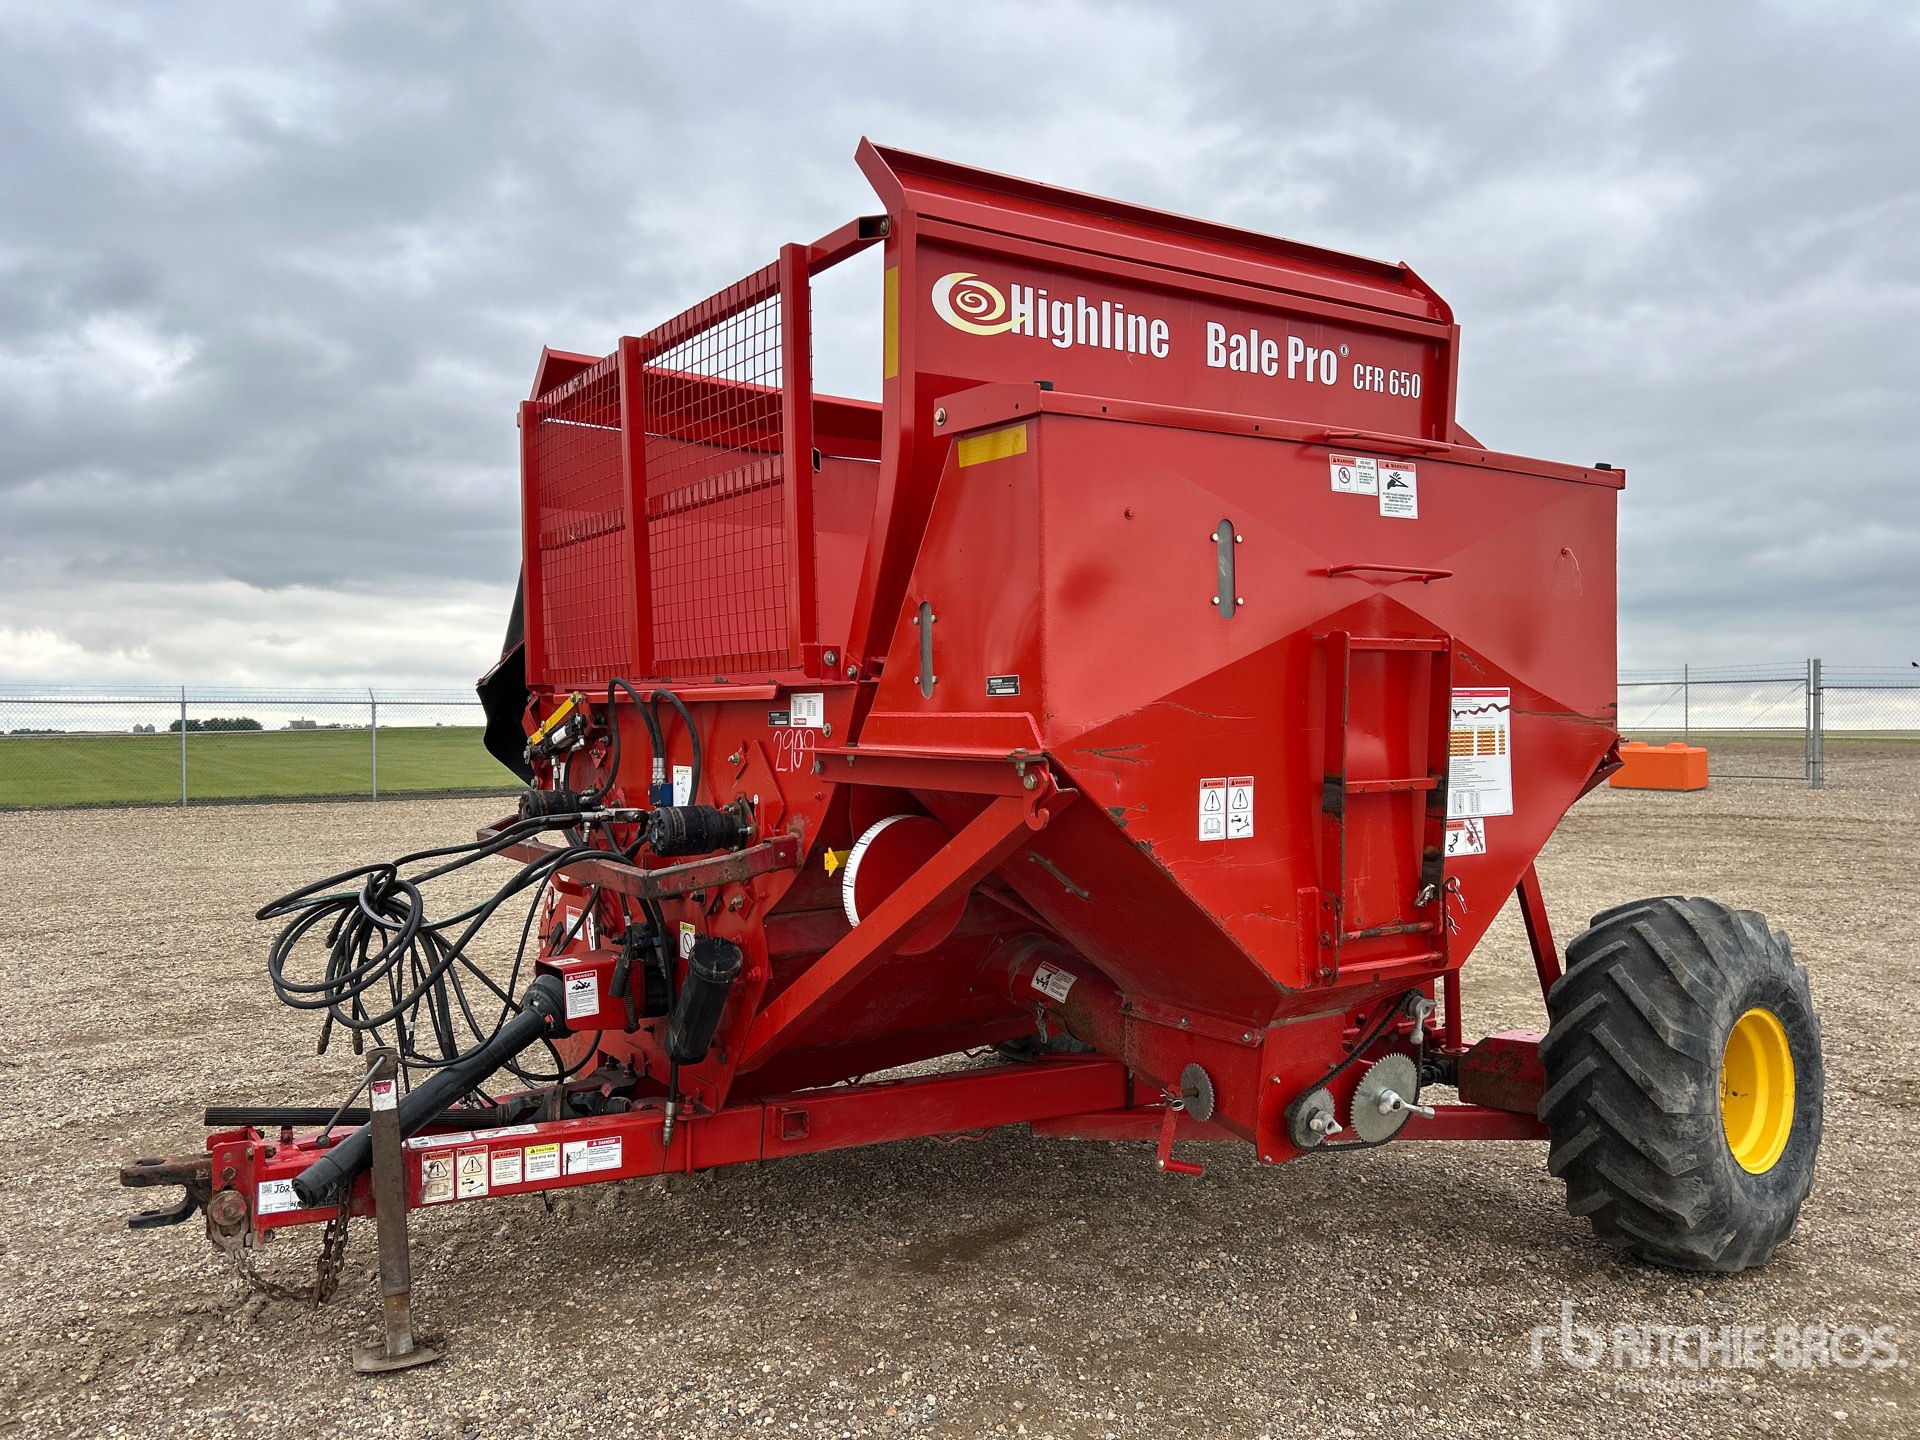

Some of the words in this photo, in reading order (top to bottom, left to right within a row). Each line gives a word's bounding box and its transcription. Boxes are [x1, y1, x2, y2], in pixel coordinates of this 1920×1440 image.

[1010, 283, 1170, 359] Highline
[1206, 321, 1279, 377] Bale
[1353, 363, 1384, 393] CFR
[1389, 369, 1421, 399] 650
[574, 972, 594, 980] DANGER
